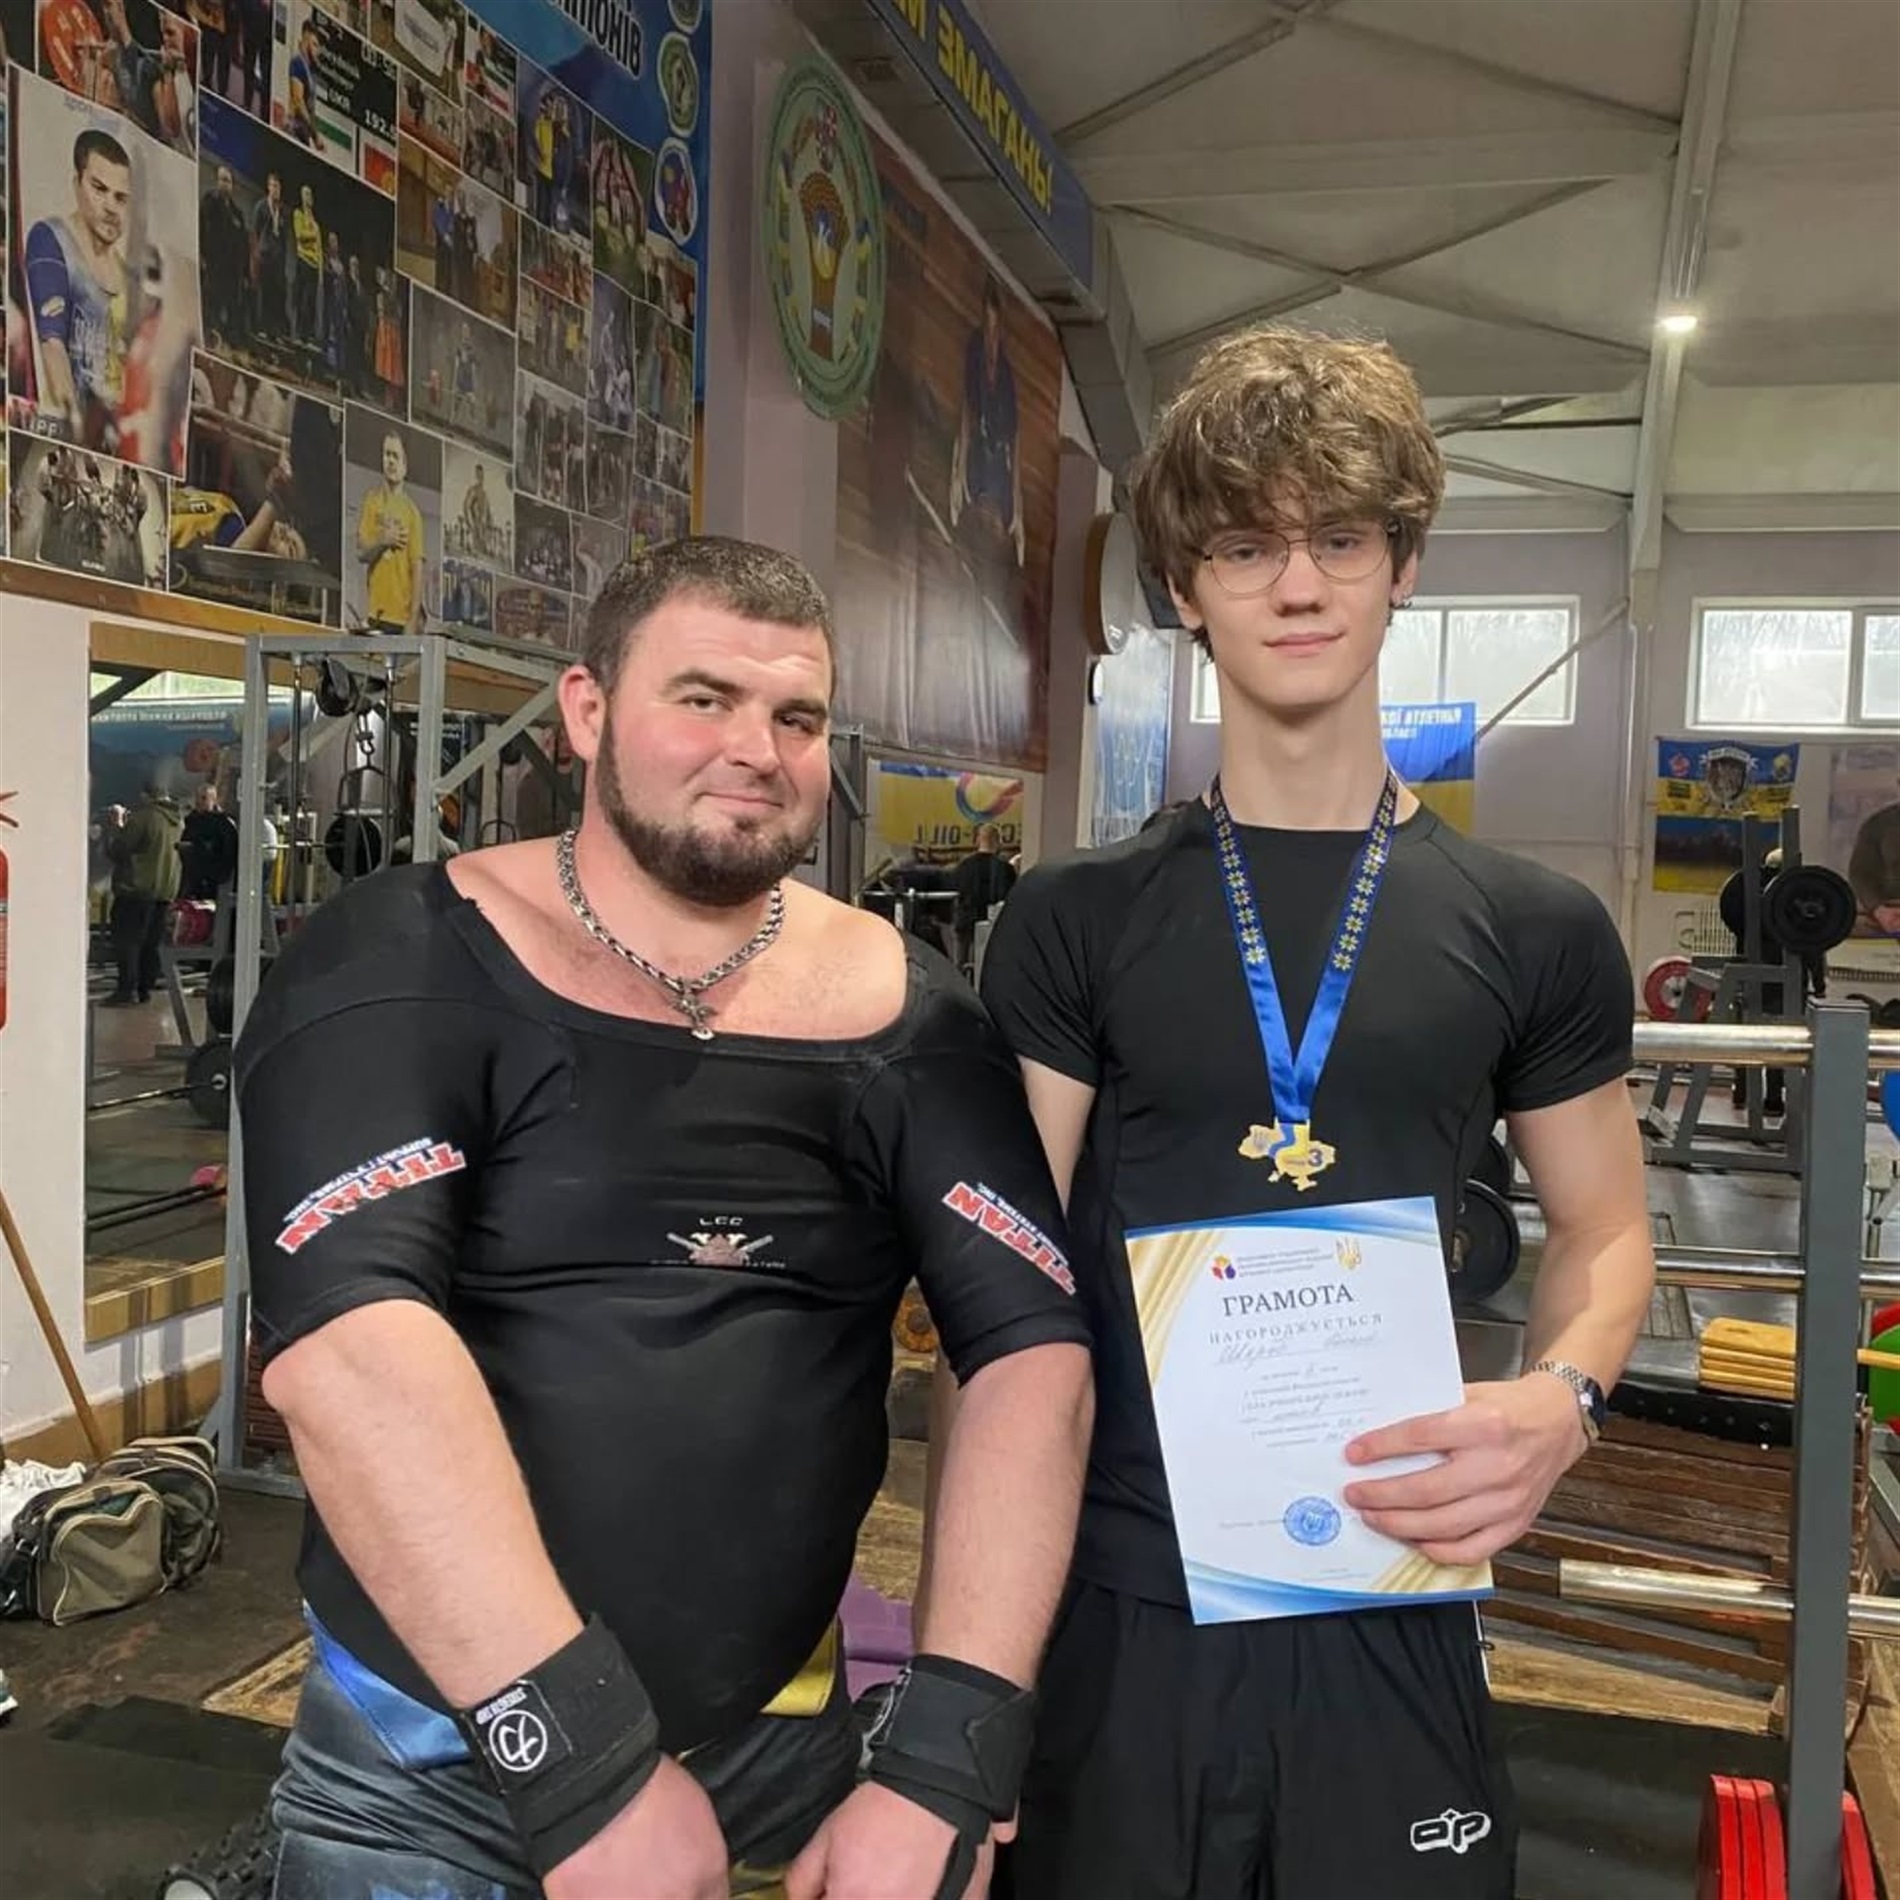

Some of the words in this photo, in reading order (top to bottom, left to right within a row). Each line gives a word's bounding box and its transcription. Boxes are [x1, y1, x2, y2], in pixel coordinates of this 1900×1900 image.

[275, 1141, 467, 1255] TITAN
[942, 1181, 1077, 1296] TITAN
[1209, 1313, 1384, 1344] НАГОРОДЖУЄТЬСЯ
[1222, 1282, 1355, 1317] ГРАМОТА
